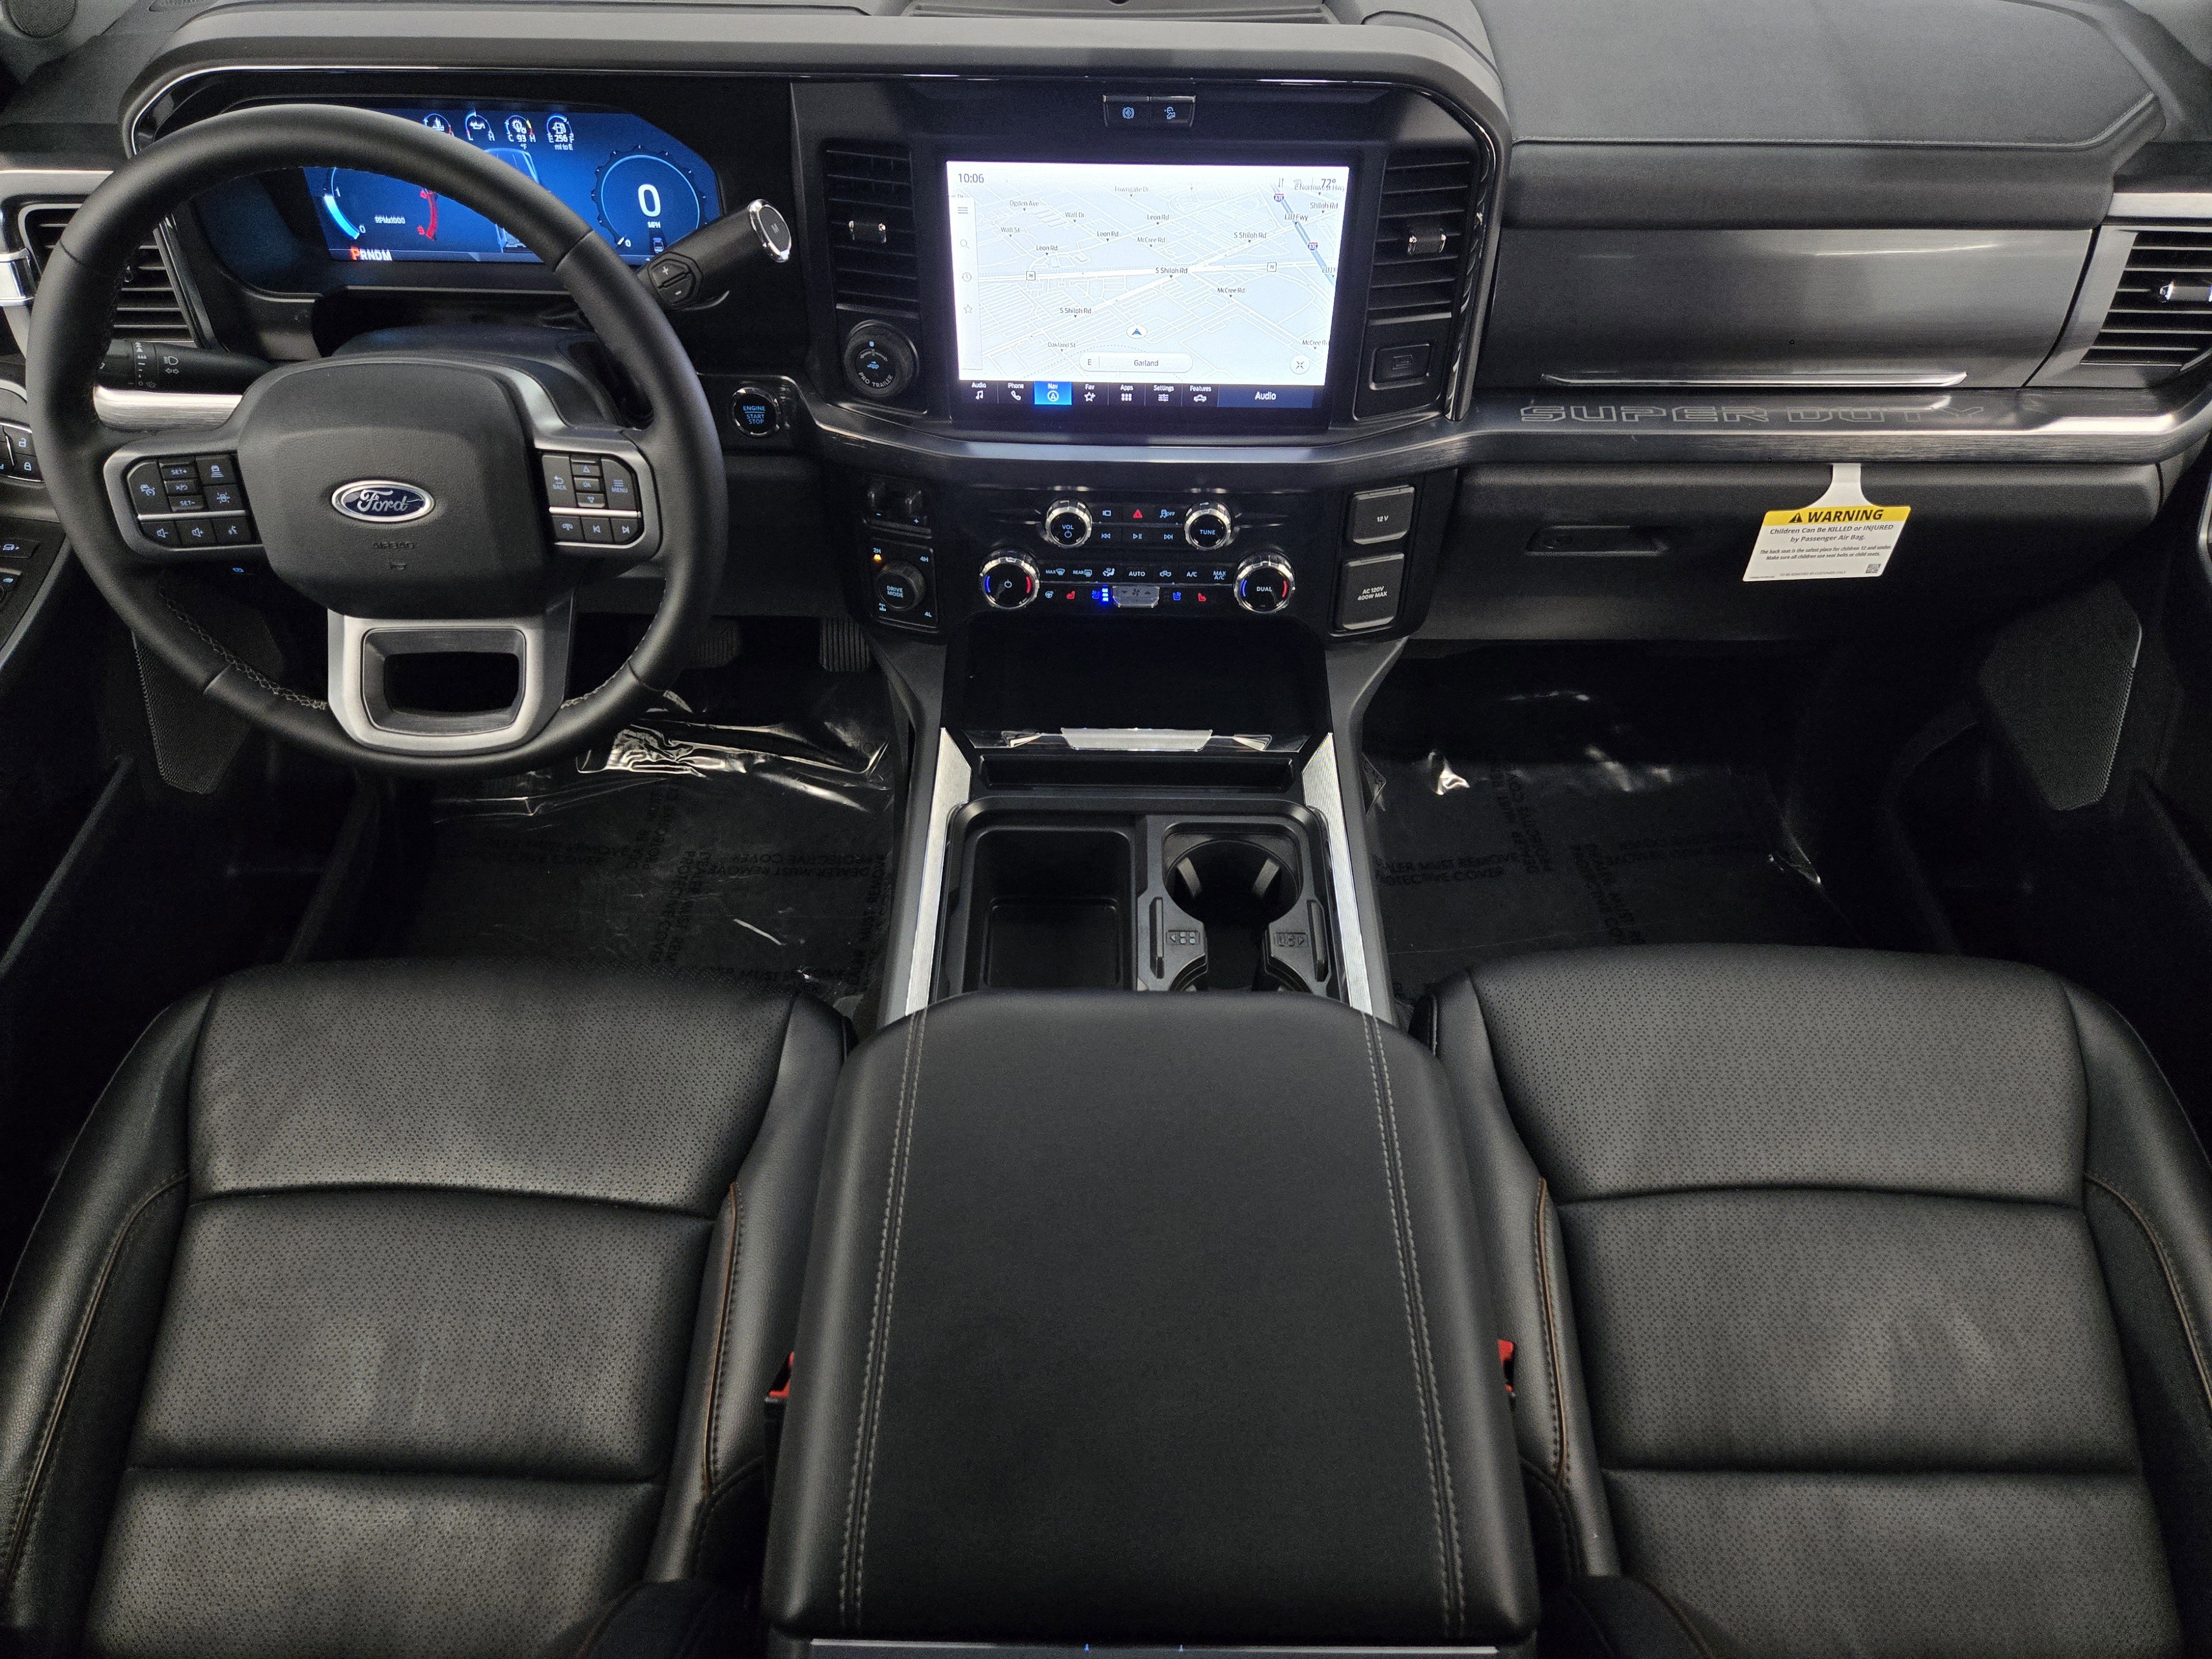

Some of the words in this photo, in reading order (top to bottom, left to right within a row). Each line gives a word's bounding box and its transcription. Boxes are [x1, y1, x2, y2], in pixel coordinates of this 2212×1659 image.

[488, 133, 495, 142] H
[958, 173, 984, 184] 10:06
[638, 184, 661, 217] 0
[359, 225, 366, 233] 0
[858, 372, 870, 384] PRO
[872, 374, 894, 388] TRAILER
[1255, 392, 1276, 400] Audio
[1520, 405, 1769, 422] SUPER
[1787, 406, 1985, 423] DUTY
[357, 489, 416, 512] Ford
[1808, 509, 1884, 523] WARNING
[1357, 593, 1374, 601] 400W
[1374, 590, 1387, 598] MAX
